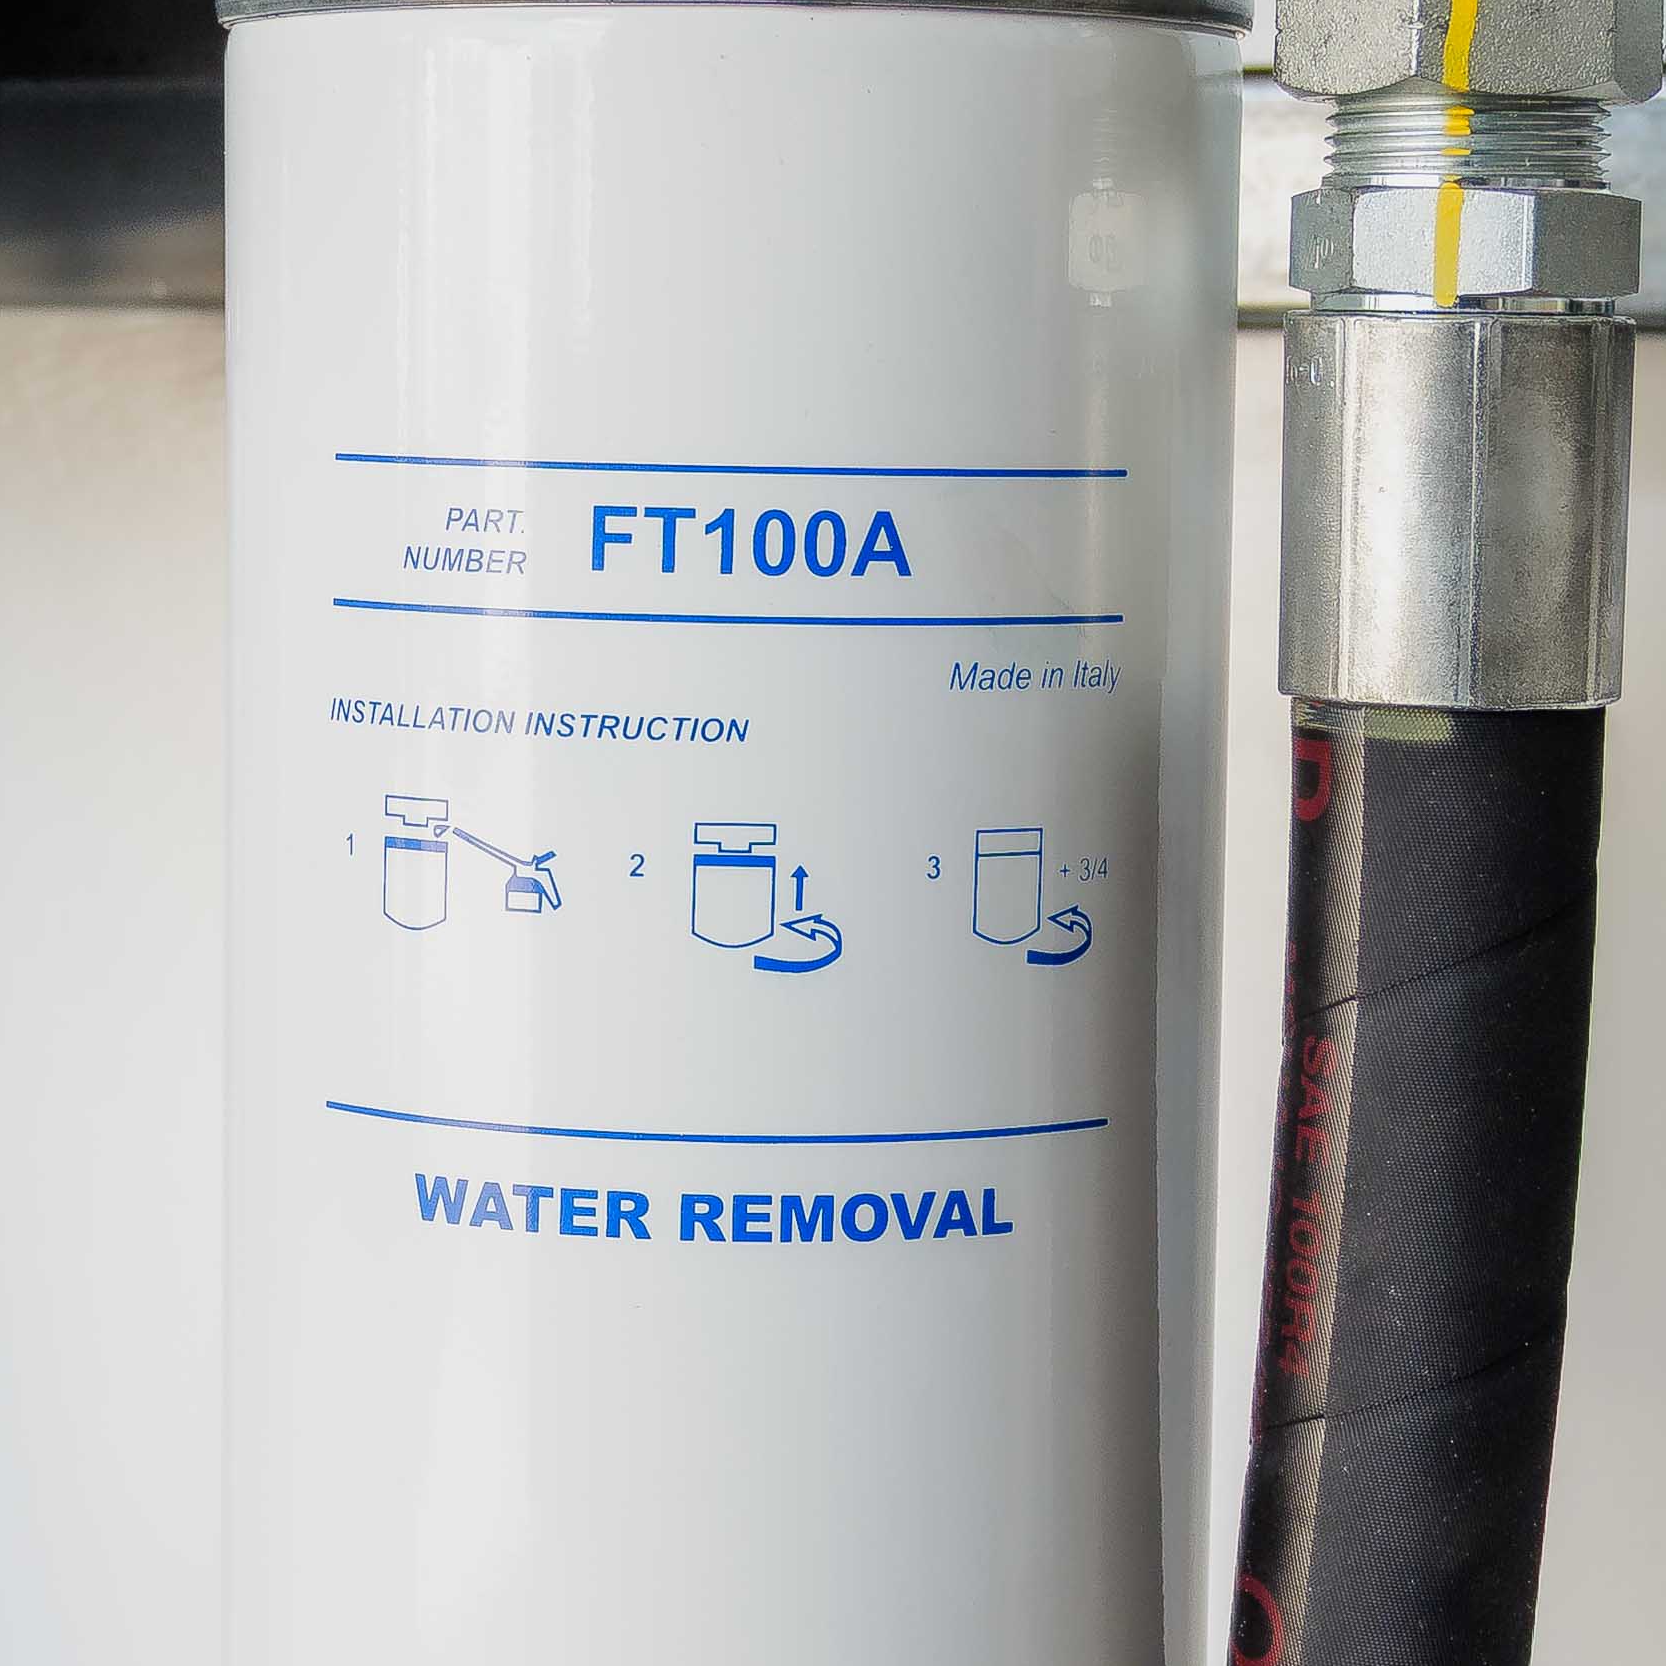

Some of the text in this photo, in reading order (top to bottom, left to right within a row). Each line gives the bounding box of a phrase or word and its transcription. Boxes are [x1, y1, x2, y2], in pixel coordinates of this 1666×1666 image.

[445, 507, 525, 534] PART.
[591, 504, 914, 579] FT100A
[402, 545, 527, 575] NUMBER
[949, 659, 1123, 696] Made in Italy
[330, 697, 751, 745] INSTALLATION INSTRUCTION
[345, 832, 356, 857] 1
[628, 853, 646, 879] 2
[925, 853, 942, 880] 3
[1295, 1035, 1336, 1165] SAE
[414, 1172, 1014, 1244] WATER REMOVAL
